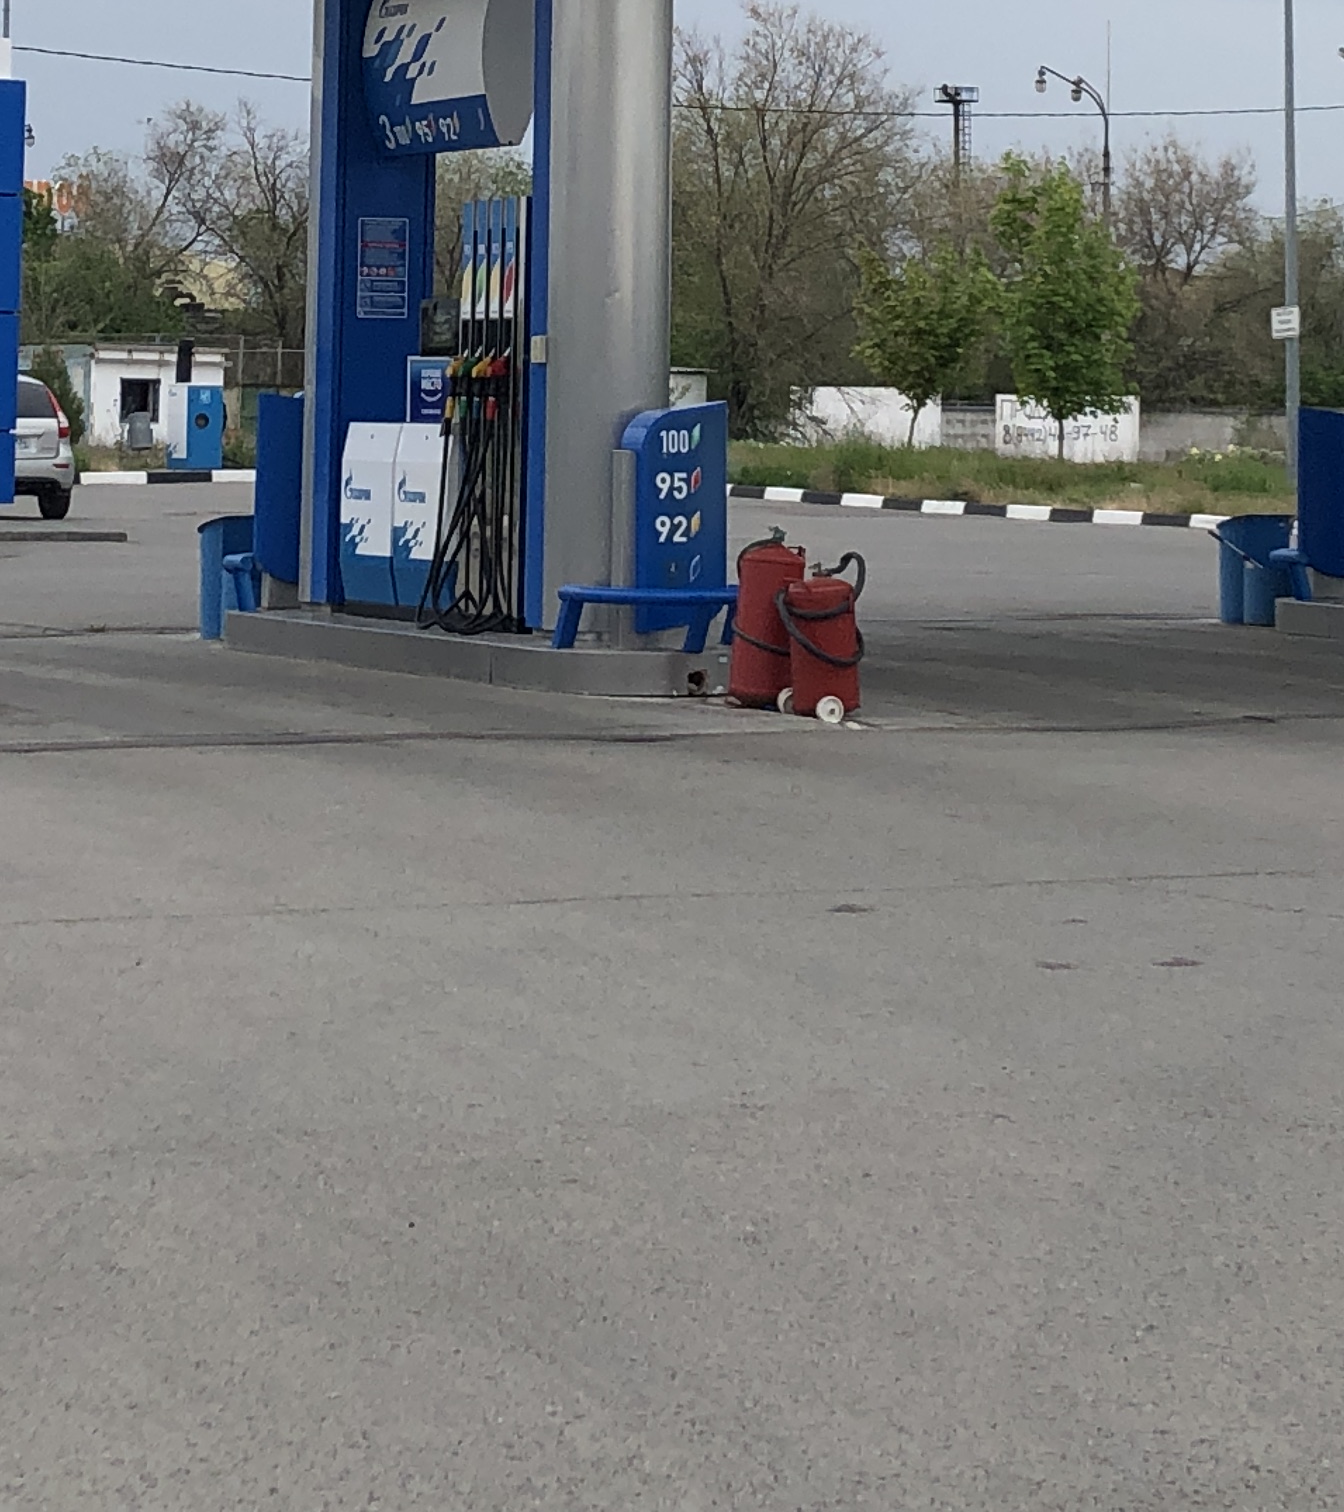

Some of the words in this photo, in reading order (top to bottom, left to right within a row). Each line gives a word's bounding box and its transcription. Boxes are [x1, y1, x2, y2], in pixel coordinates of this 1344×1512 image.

[378, 114, 396, 149] 3
[415, 120, 433, 143] 95
[438, 117, 458, 141] 92
[659, 429, 690, 454] 100
[655, 472, 688, 500] 95
[655, 515, 688, 543] 92
